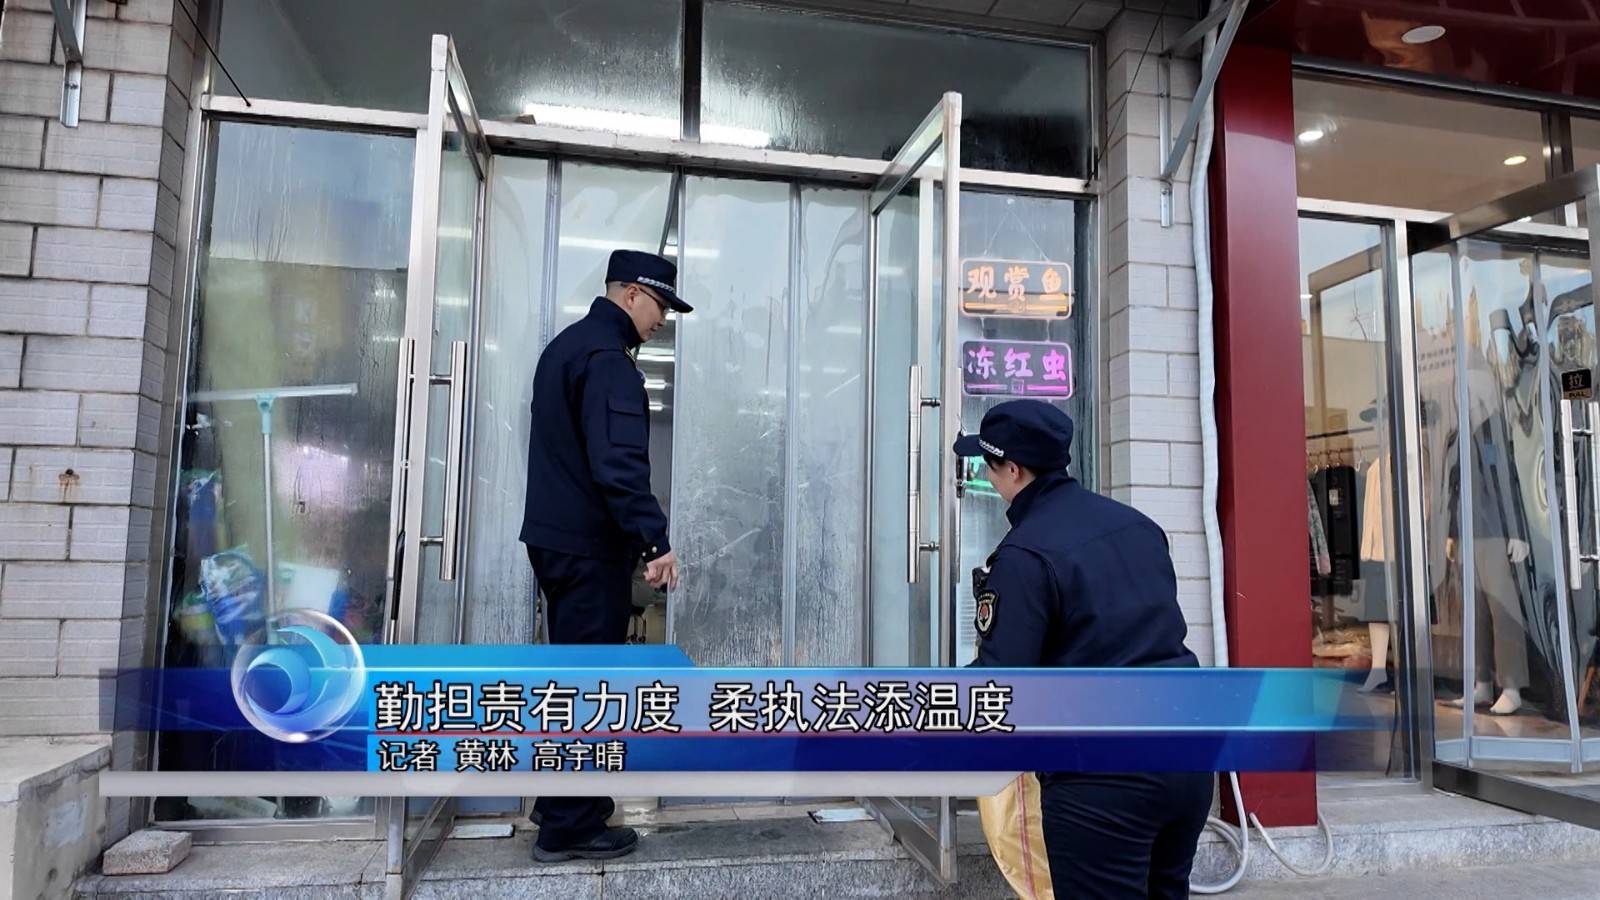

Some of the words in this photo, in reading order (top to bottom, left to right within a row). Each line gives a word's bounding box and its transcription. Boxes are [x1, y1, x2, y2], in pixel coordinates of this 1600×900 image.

[967, 266, 1067, 301] 观赏鱼
[967, 346, 1067, 381] 冻红虫
[1569, 373, 1585, 390] 拉
